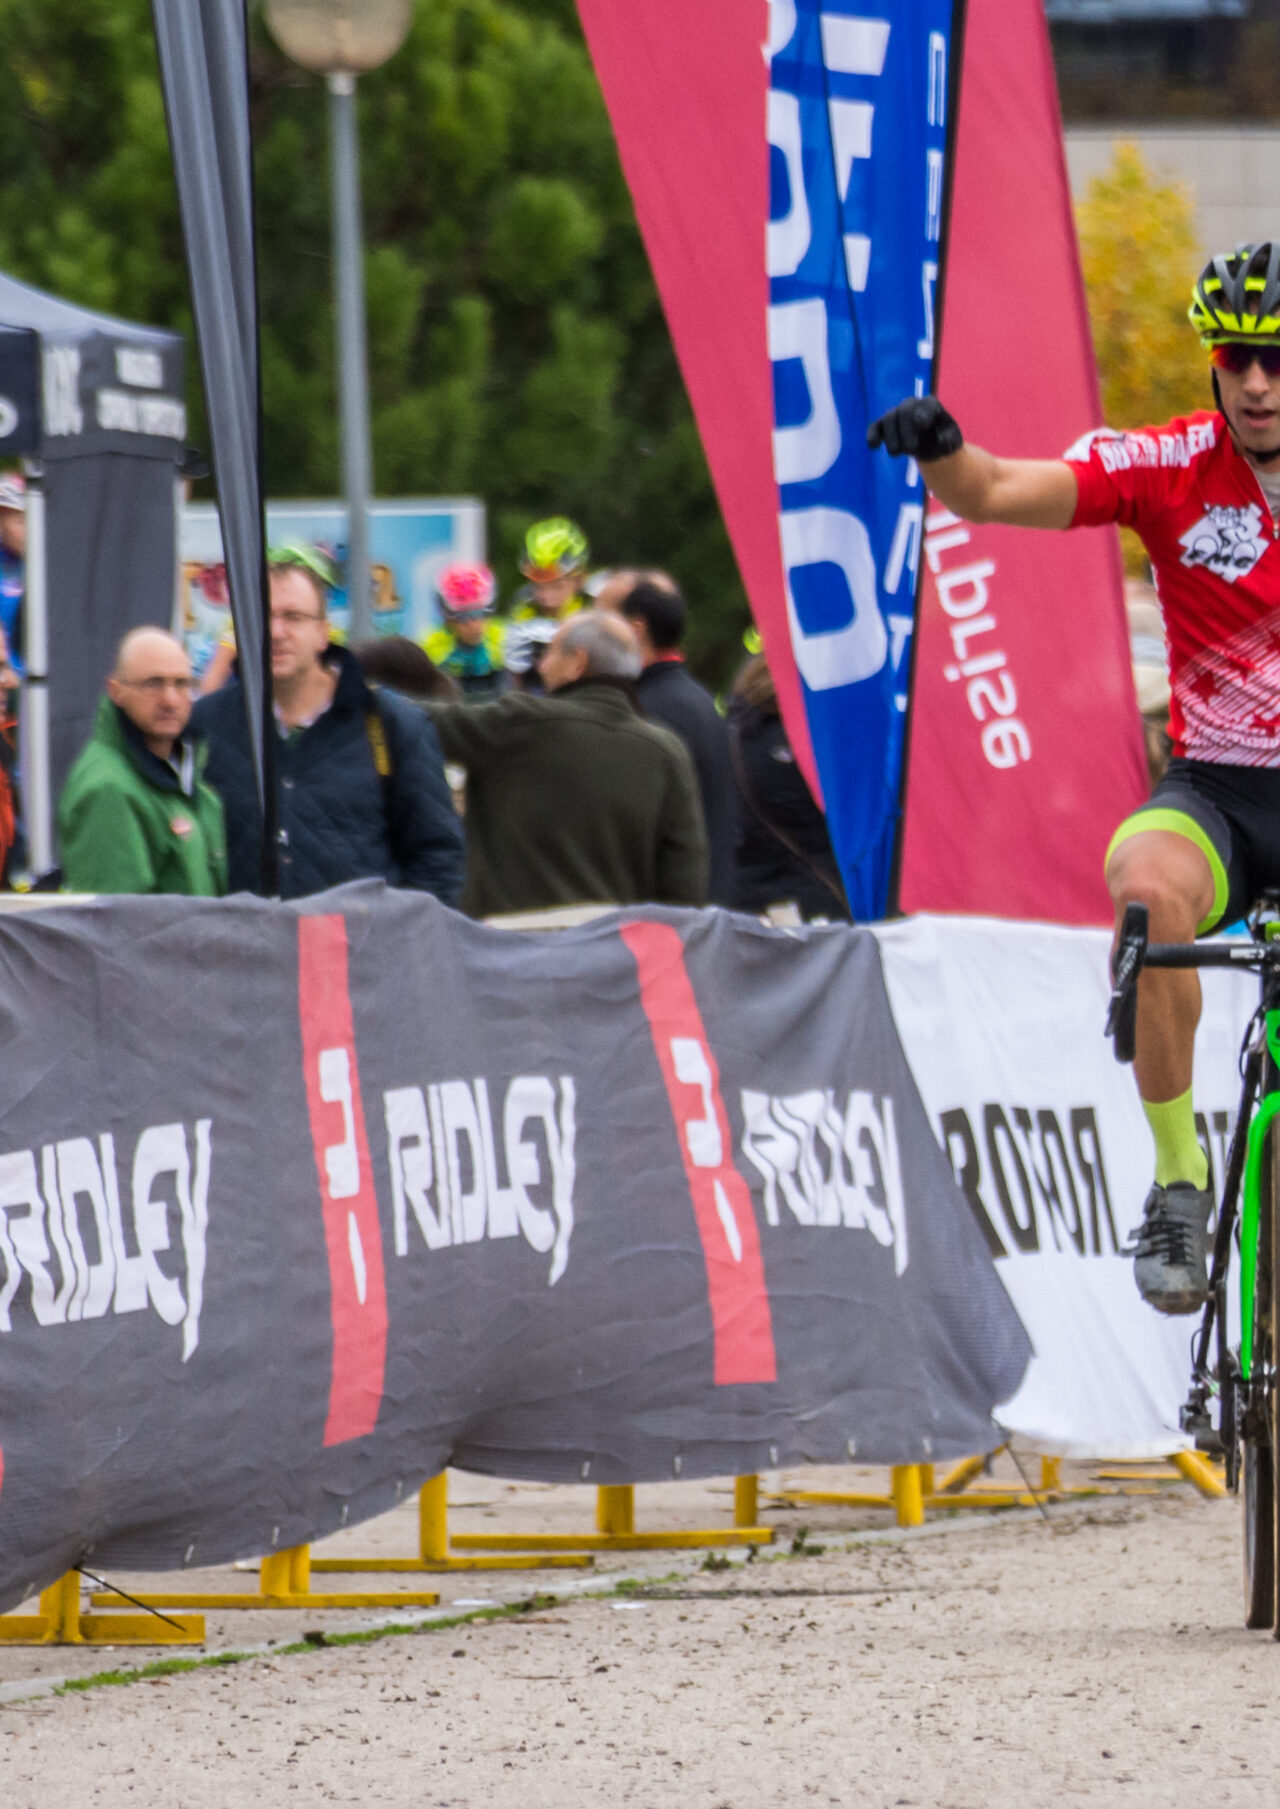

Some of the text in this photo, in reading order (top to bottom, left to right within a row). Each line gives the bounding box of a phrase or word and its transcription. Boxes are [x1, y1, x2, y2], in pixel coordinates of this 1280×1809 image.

[0, 1118, 212, 1362] RIDLEY
[383, 1076, 576, 1286] RIDLEY
[740, 1087, 909, 1278] RIDLEY
